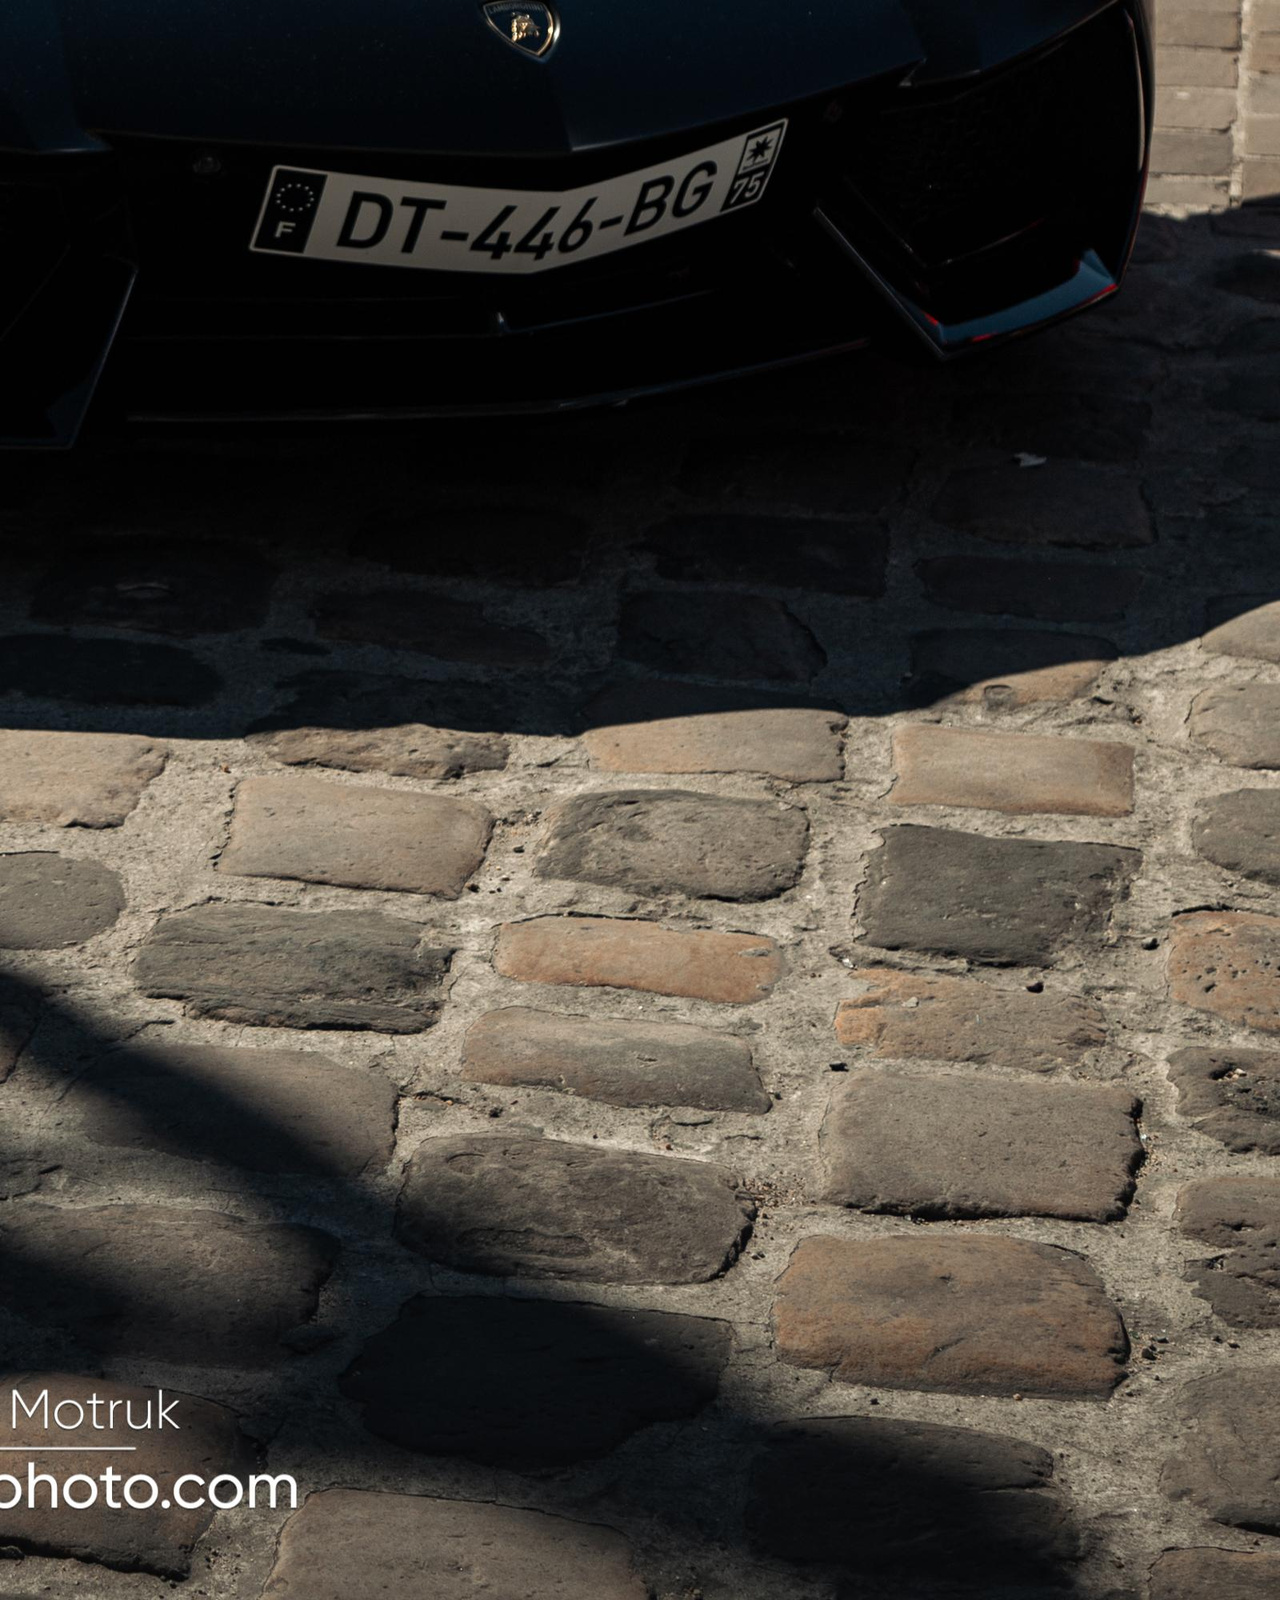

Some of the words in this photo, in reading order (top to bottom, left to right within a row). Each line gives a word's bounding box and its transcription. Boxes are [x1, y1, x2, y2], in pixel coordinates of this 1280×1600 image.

[274, 221, 297, 239] F
[335, 160, 719, 262] DT-446-BG
[730, 170, 766, 205] 75
